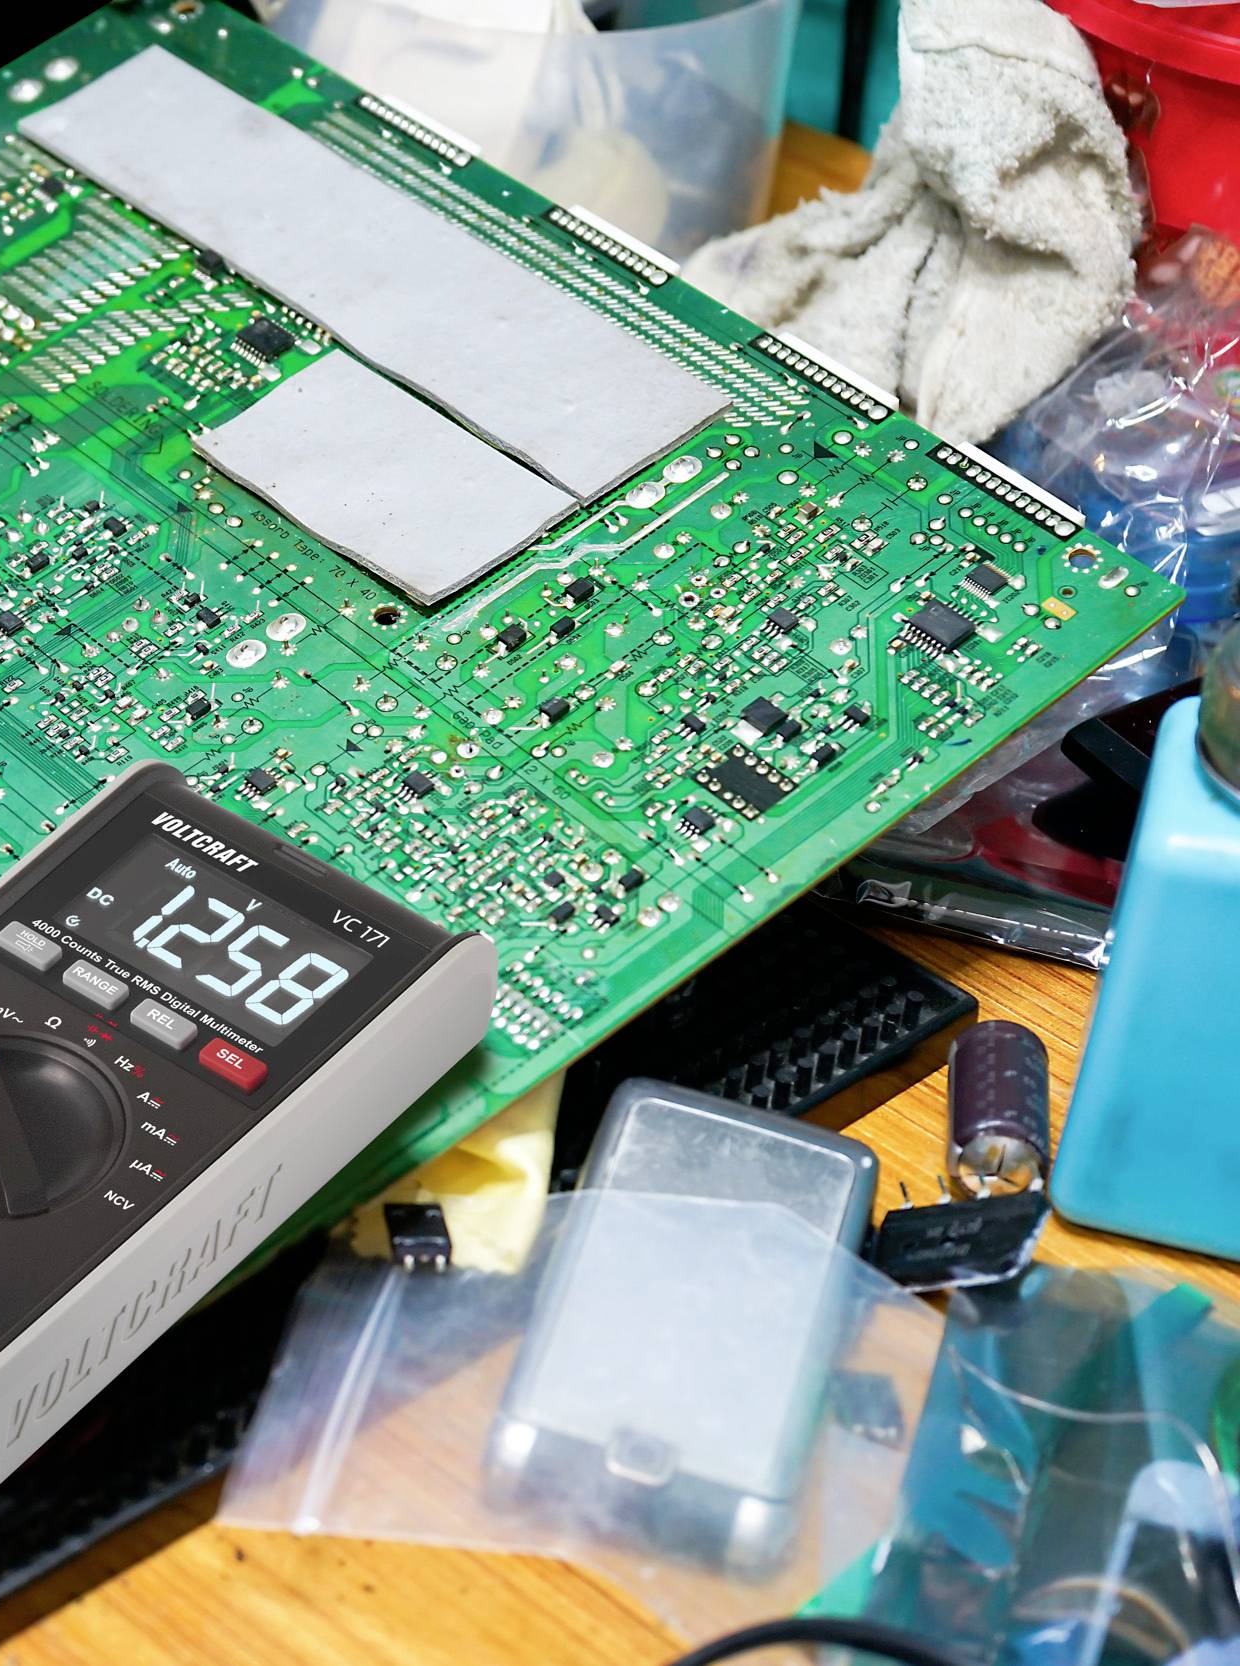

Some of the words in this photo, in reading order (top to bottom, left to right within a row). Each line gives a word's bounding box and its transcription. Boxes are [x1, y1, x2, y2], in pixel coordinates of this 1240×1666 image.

[250, 510, 290, 539] Absorb
[328, 565, 346, 578] 70
[361, 588, 377, 600] 40
[150, 812, 259, 873] VOLTCRAFT
[165, 857, 197, 880] Auto
[86, 887, 114, 906] DC
[246, 898, 263, 913] V
[20, 930, 47, 947] HOLD
[331, 909, 362, 932] VC
[359, 925, 391, 948] 171
[133, 885, 349, 1025] 1.258
[31, 919, 61, 938] 4000
[61, 935, 103, 963] Counts
[105, 959, 131, 979] True
[131, 975, 161, 995] RMS
[160, 991, 202, 1018] Digital
[200, 1014, 264, 1054] Multimeter
[72, 966, 119, 996] RANGE
[146, 1008, 175, 1030] REL
[216, 1048, 245, 1069] SEL
[103, 1190, 135, 1211] NCV
[7, 1162, 283, 1448] VOLTCRAFT
